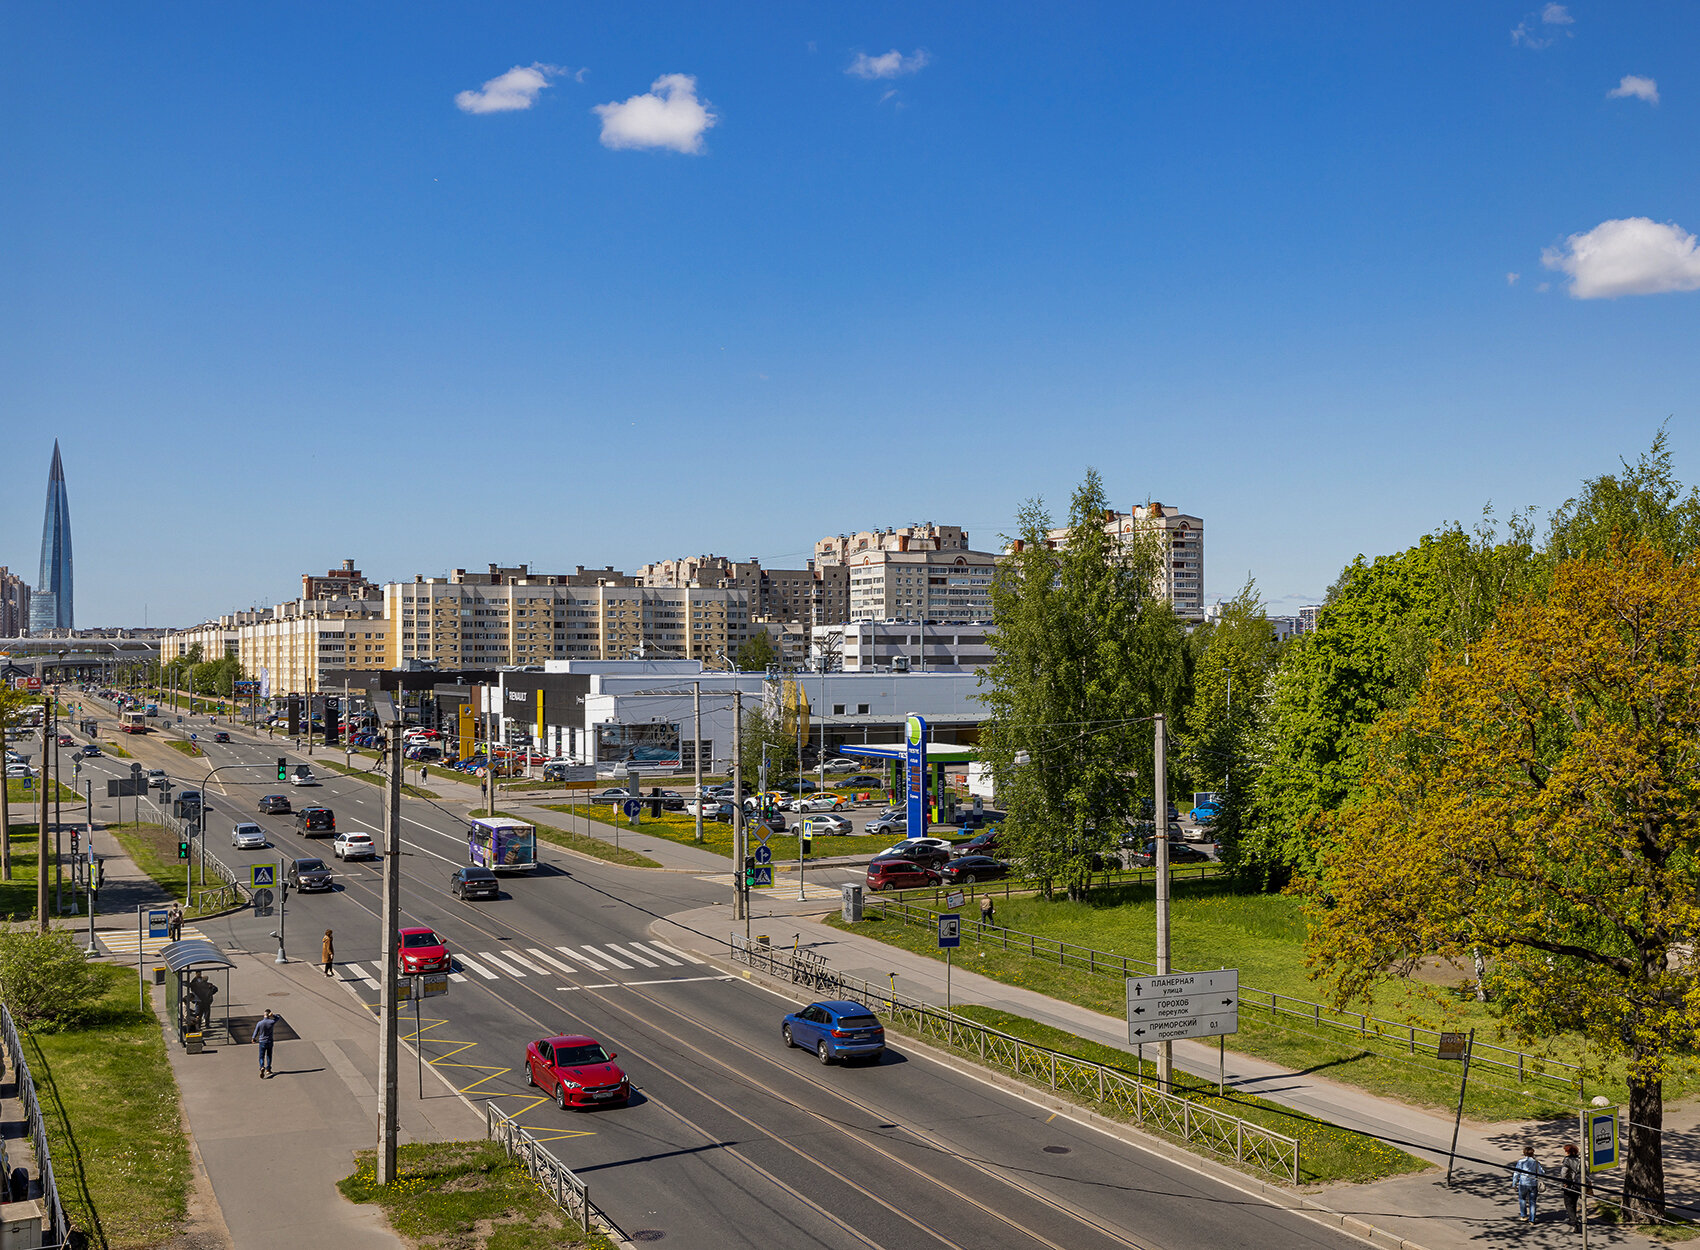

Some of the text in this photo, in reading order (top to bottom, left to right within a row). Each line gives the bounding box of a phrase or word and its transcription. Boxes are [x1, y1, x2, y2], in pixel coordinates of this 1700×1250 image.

[509, 691, 527, 702] RENAULT
[1151, 977, 1194, 987] ПЛАНЕРНАЯ
[1163, 987, 1183, 996] улица
[1157, 999, 1189, 1008] ГОРОХОВ
[1158, 1009, 1189, 1018] переулок
[1149, 1018, 1197, 1030] ПРИМОРСКИЙ
[1158, 1030, 1188, 1039] проспект
